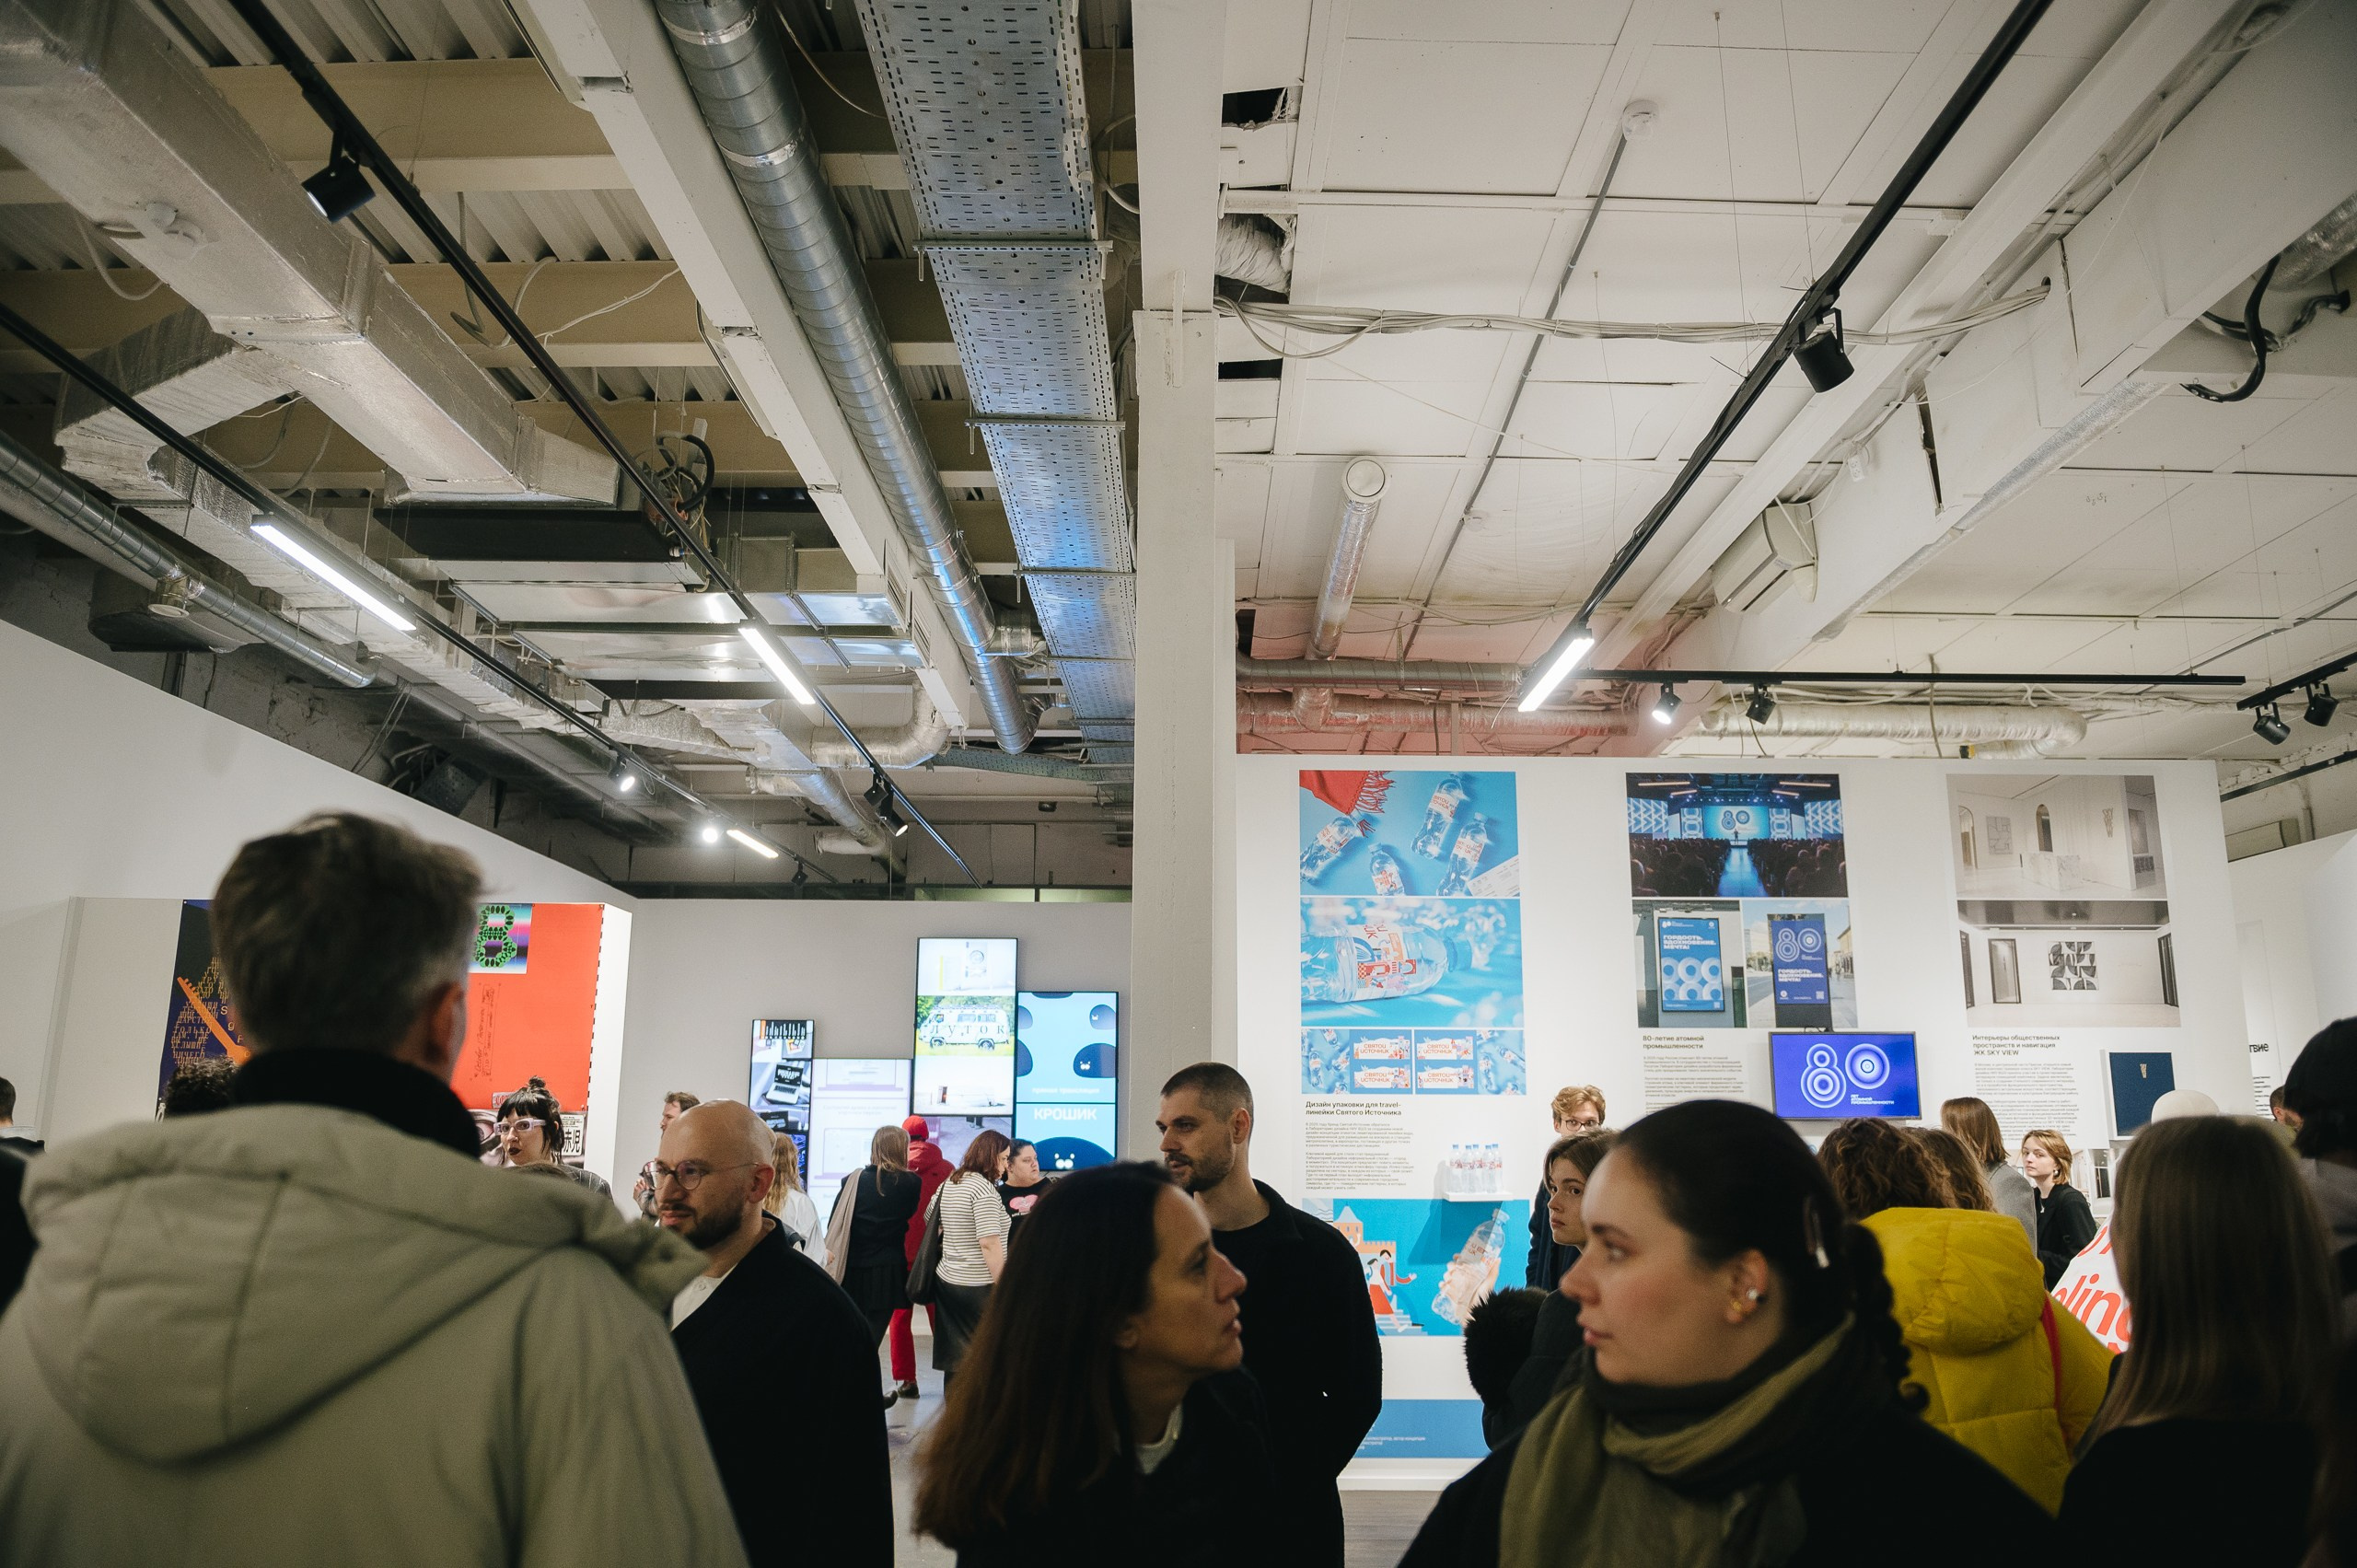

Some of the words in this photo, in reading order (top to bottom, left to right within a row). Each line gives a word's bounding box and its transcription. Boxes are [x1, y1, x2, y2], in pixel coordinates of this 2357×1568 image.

[1775, 928, 1822, 963] 80
[1801, 1043, 1890, 1109] 80
[1033, 1108, 1097, 1121] КРОШИК
[1306, 1100, 1331, 1109] Дизайн
